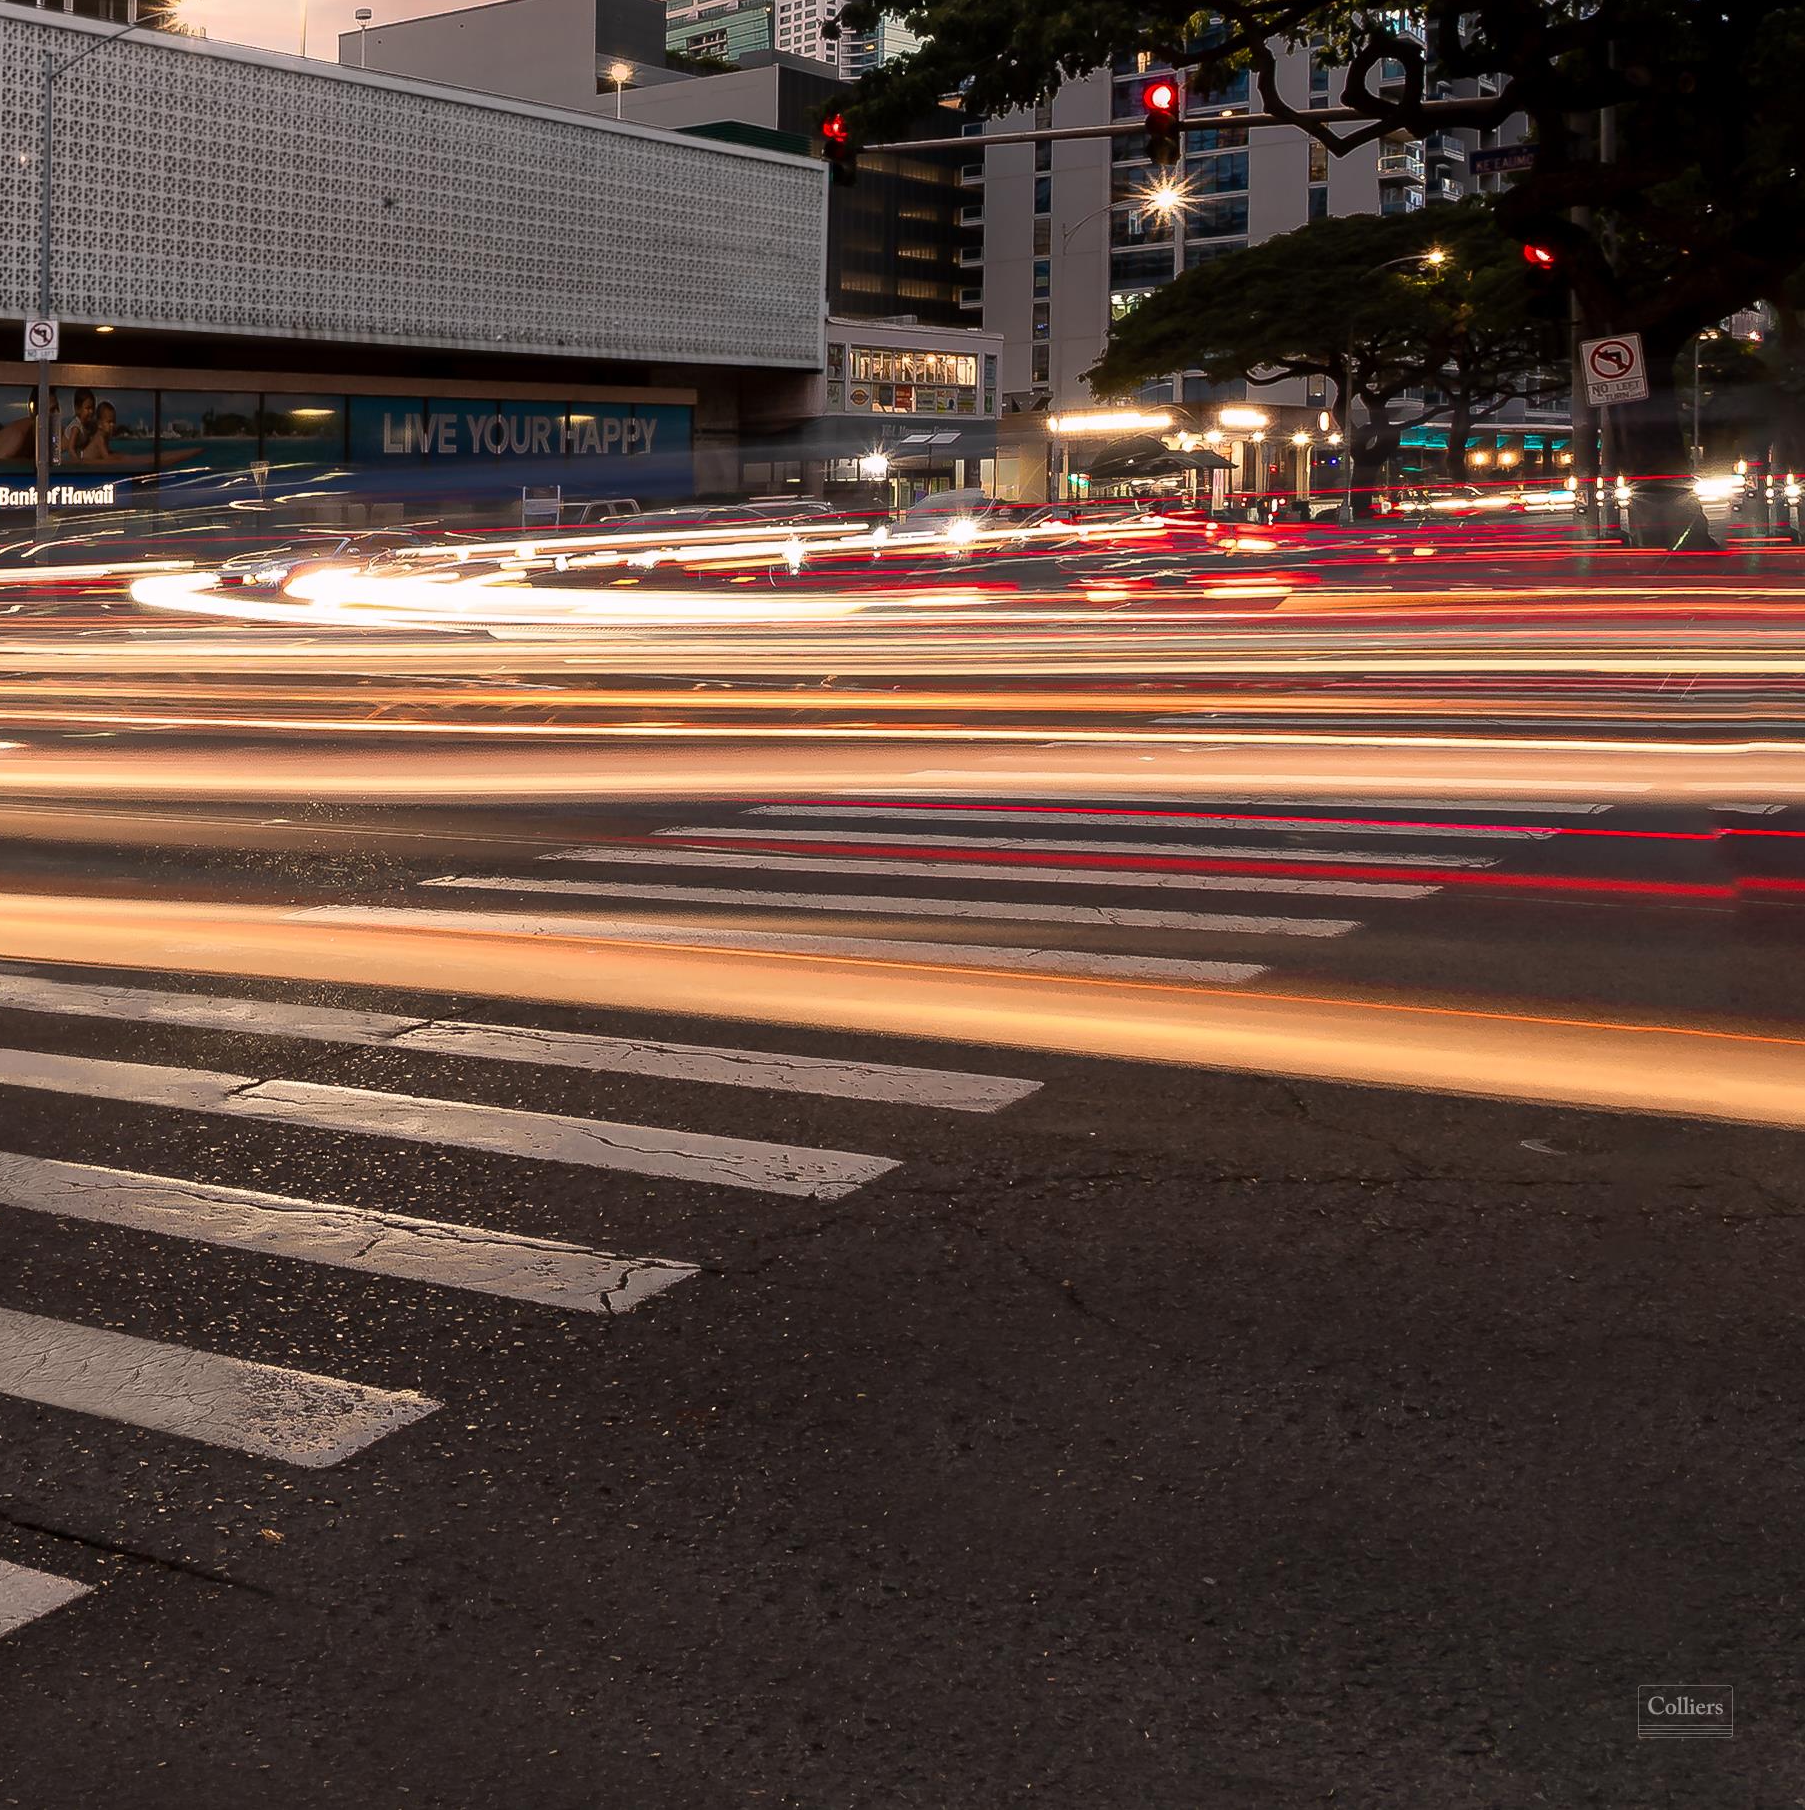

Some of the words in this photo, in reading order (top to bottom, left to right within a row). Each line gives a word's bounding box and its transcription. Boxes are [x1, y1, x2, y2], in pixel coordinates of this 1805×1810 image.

[1592, 383, 1609, 396] NO
[1616, 380, 1640, 391] LEFT
[1604, 391, 1630, 401] TURN
[383, 412, 458, 454] LIVE
[466, 414, 551, 454] YOUR
[559, 415, 658, 455] HAPPY
[61, 483, 115, 505] Hawaii
